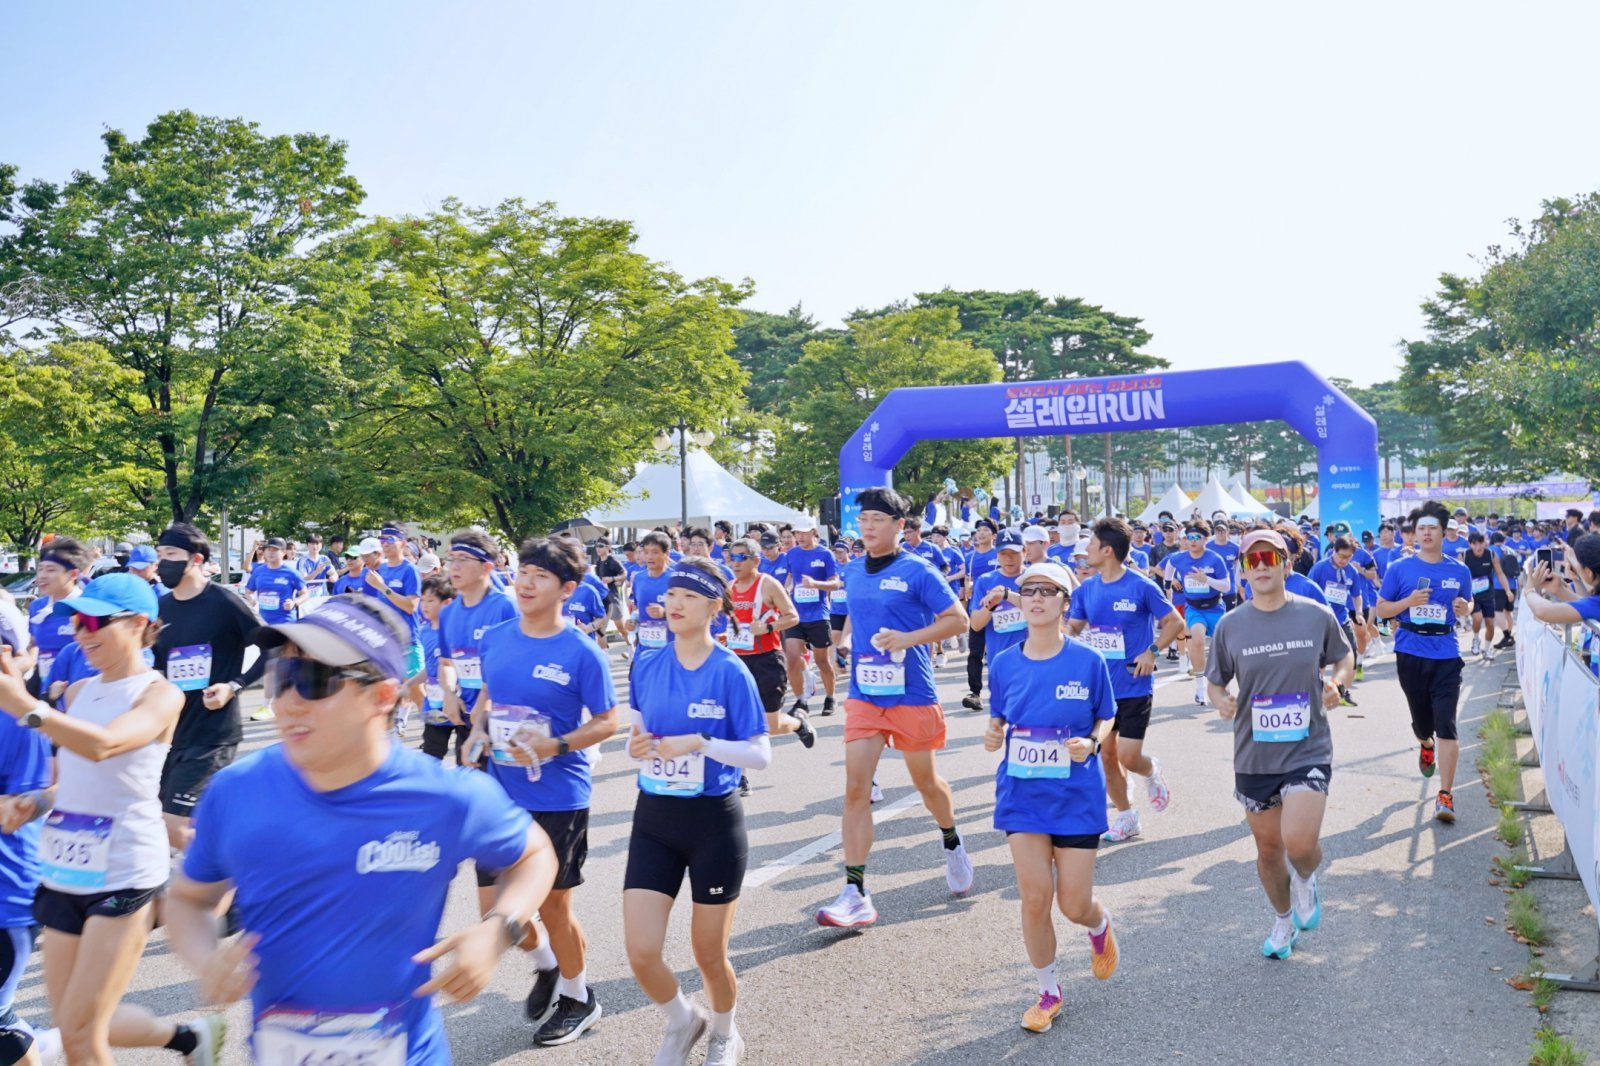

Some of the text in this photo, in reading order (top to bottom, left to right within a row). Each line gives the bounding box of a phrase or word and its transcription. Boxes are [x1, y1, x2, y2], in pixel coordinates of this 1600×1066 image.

[1003, 389, 1166, 429] 설레임RUN
[1002, 530, 1014, 542] A
[997, 611, 1021, 624] 2937
[1093, 637, 1118, 649] 2584
[1242, 639, 1314, 656] RAILROAD BERLIN
[862, 669, 895, 684] 3319
[1259, 711, 1304, 729] 0043
[1018, 745, 1059, 764] 0014
